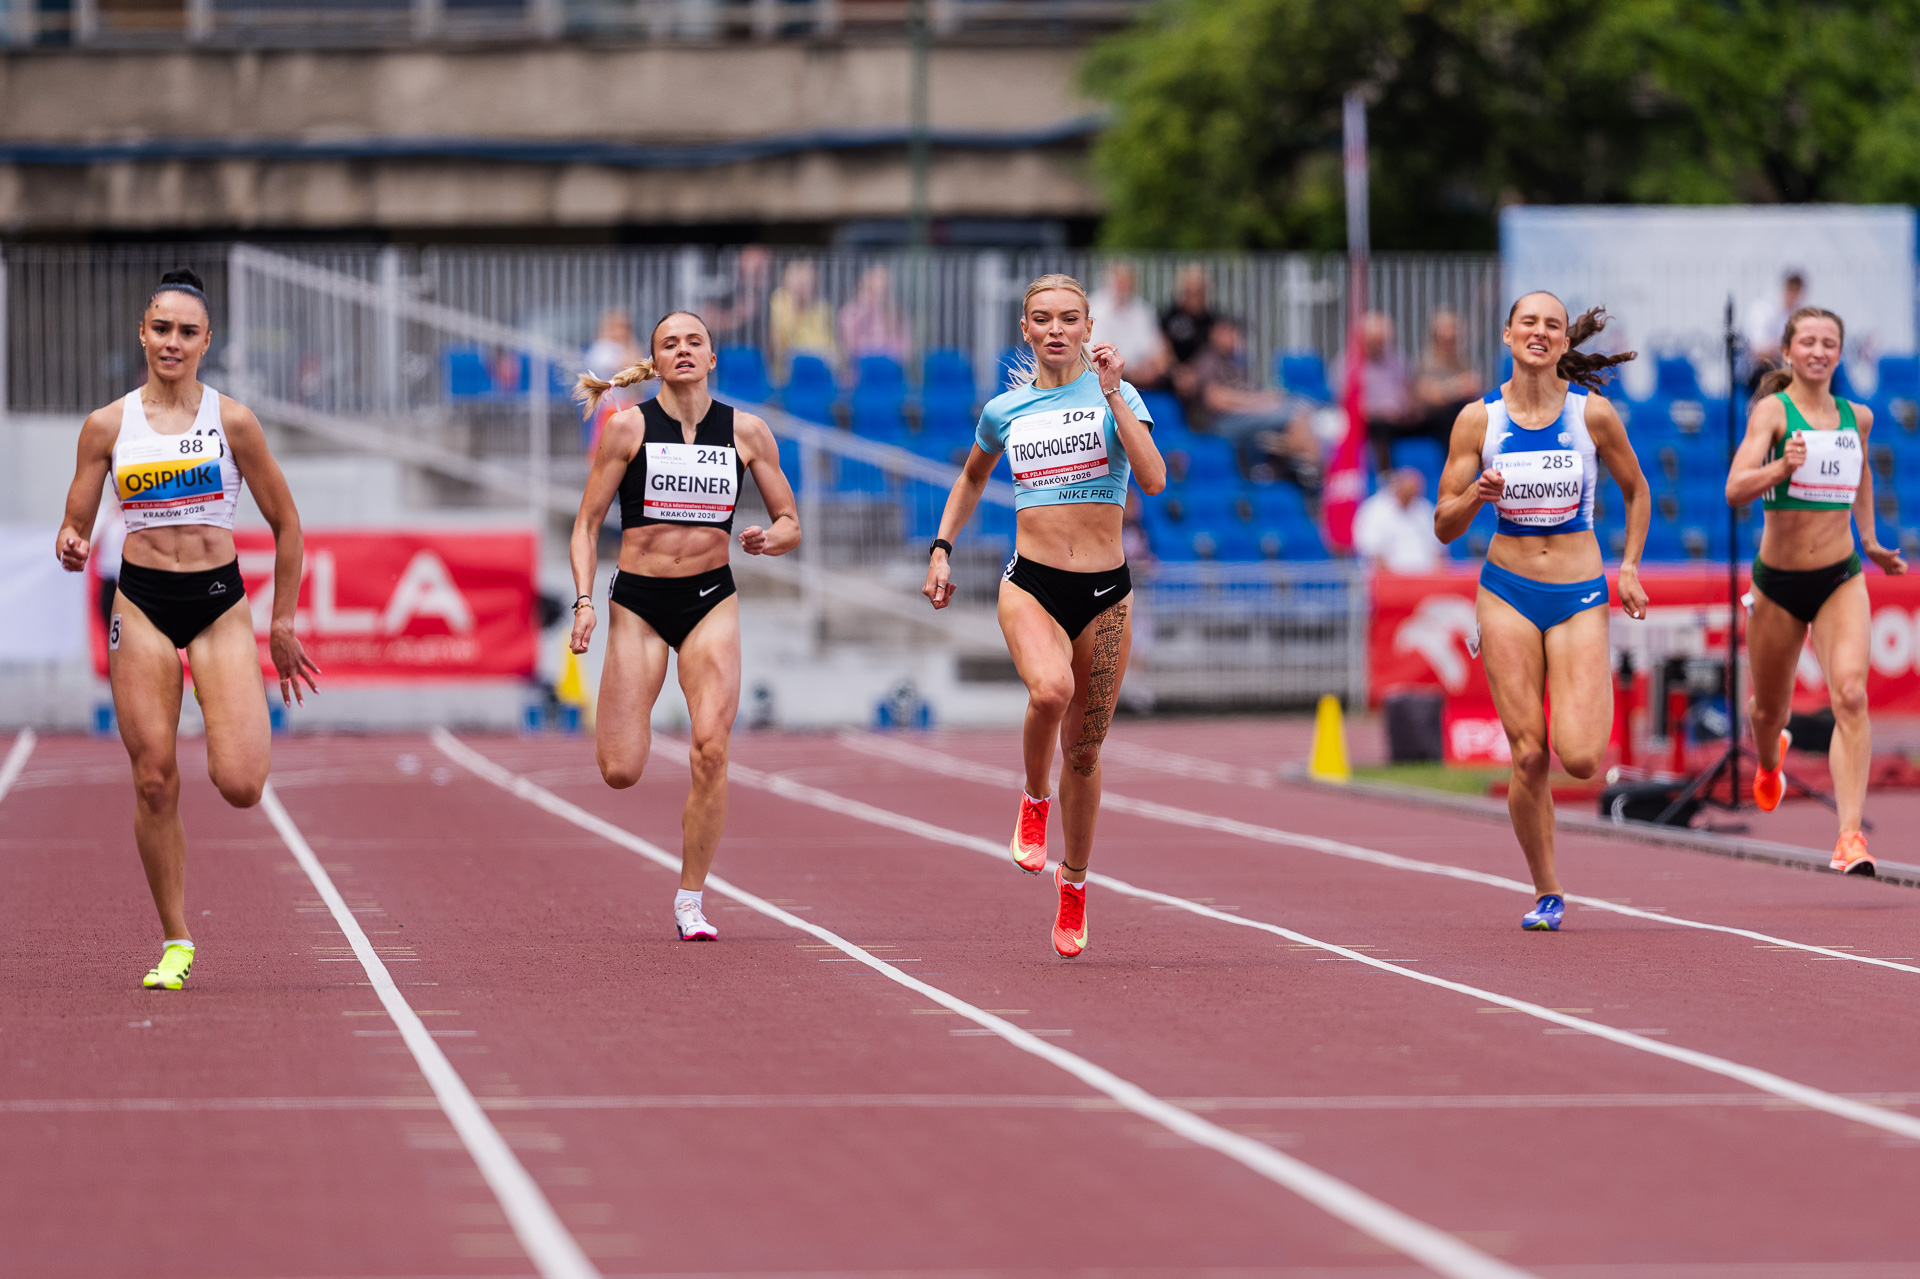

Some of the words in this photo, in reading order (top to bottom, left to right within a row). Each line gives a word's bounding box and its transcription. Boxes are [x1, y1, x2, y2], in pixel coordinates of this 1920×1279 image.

[1062, 411, 1096, 424] 104
[179, 439, 203, 454] 88
[1012, 432, 1102, 462] TROCHOLEPSZA
[1835, 435, 1856, 449] 406
[697, 450, 728, 465] 241
[1505, 460, 1532, 468] Kraków
[1542, 455, 1573, 469] 285
[1030, 470, 1042, 478] PZLA
[1820, 460, 1840, 476] LIS
[125, 466, 213, 492] OSIPIUK
[651, 474, 730, 494] GREINER
[1032, 476, 1069, 487] KRAKÓW
[1071, 472, 1091, 481] 2026
[1059, 490, 1088, 500] NIKE
[1090, 490, 1113, 498] PRO
[143, 509, 182, 519] KRAKÓW
[184, 505, 205, 515] 2026
[660, 510, 696, 518] KRAKÓW
[1513, 515, 1546, 523] KRAKÓW
[110, 620, 119, 644] 5
